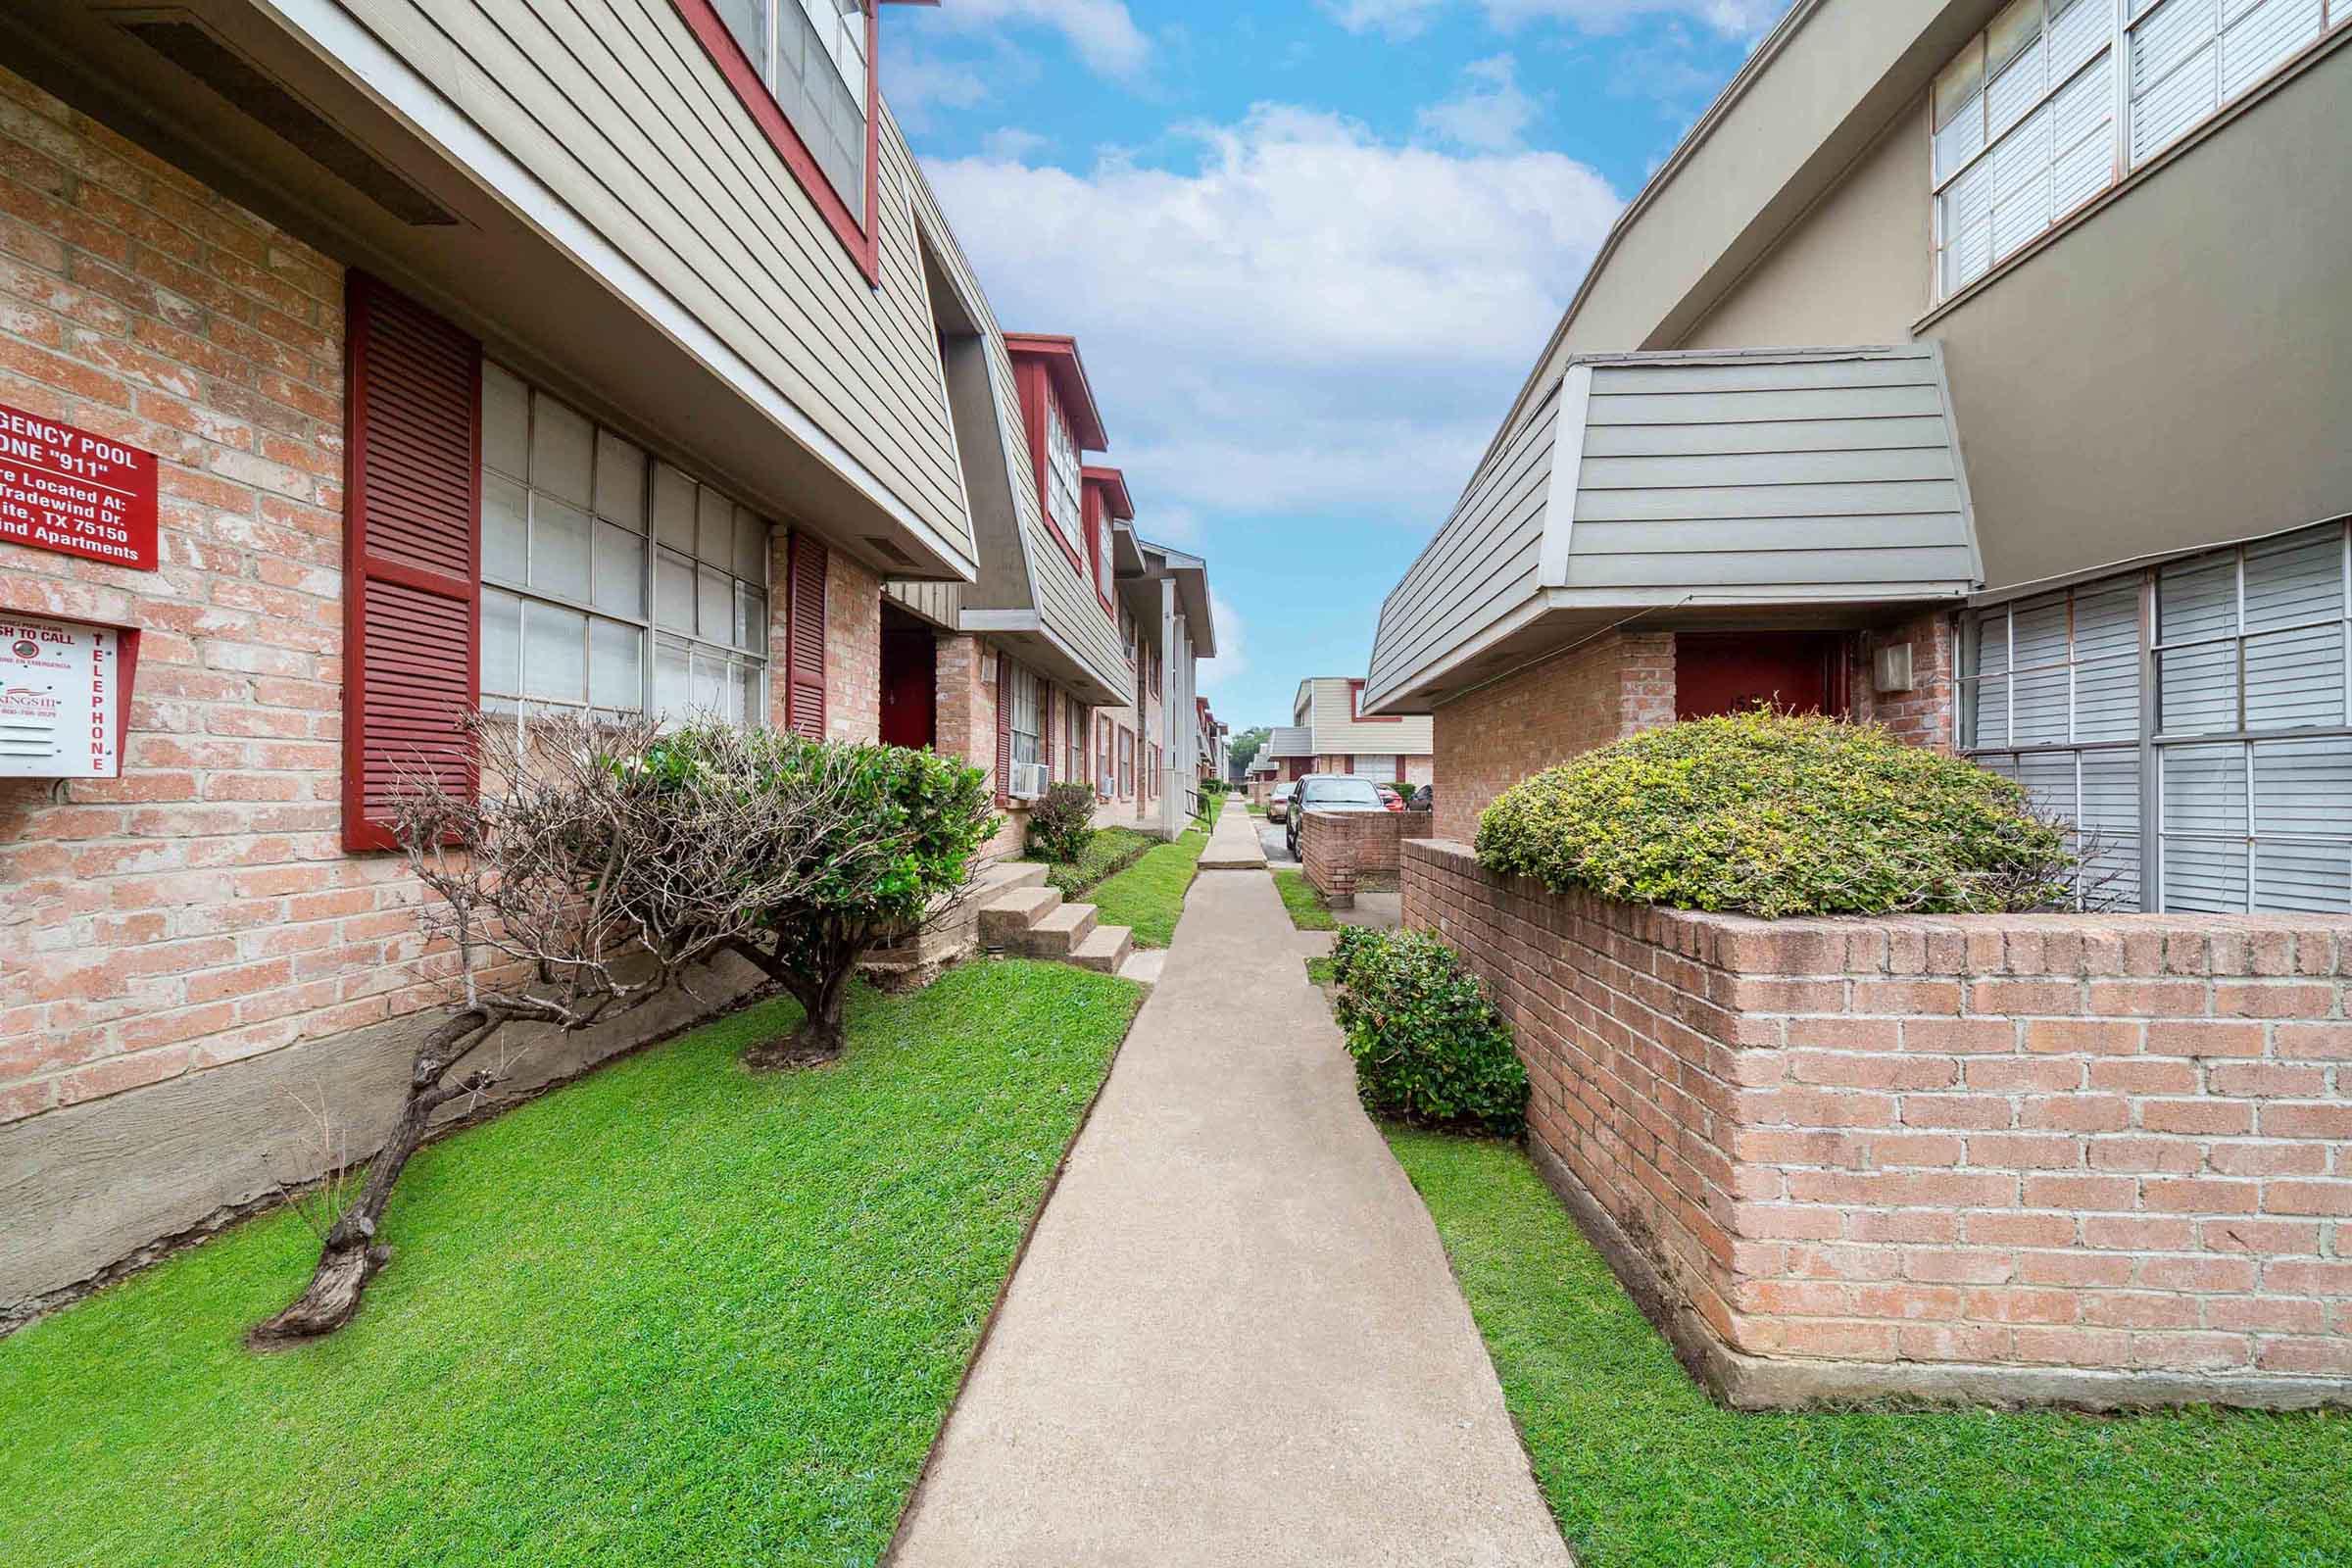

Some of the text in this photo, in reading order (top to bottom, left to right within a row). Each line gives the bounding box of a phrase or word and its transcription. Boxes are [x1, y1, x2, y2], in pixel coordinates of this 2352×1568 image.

[50, 449, 109, 477] "911"
[81, 437, 138, 469] POOL
[23, 473, 97, 504] Located
[103, 495, 126, 512] At:
[43, 511, 69, 529] TX
[74, 518, 127, 543] 75150
[101, 509, 125, 527] Dr.
[34, 526, 139, 561] Apartments
[18, 628, 36, 640] TO
[41, 631, 75, 645] CALL
[90, 633, 103, 770] TELEPHONE
